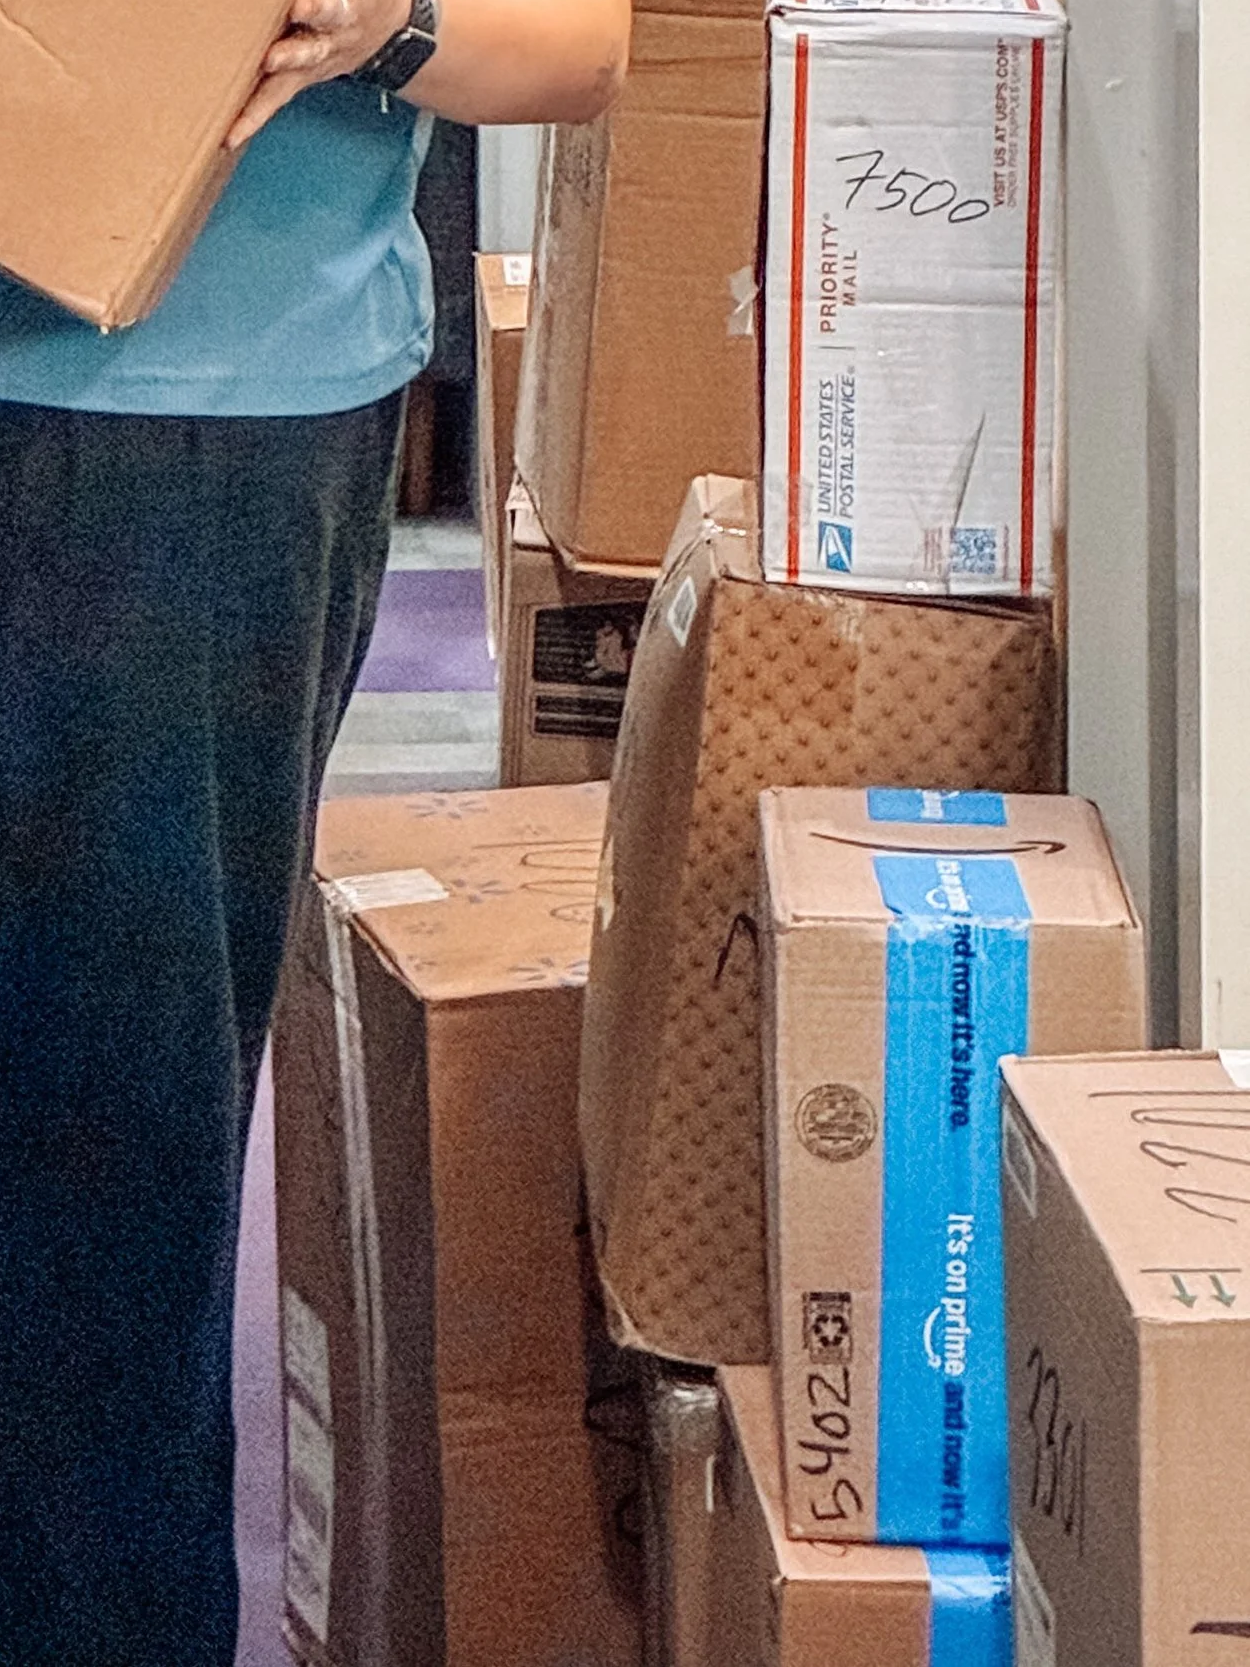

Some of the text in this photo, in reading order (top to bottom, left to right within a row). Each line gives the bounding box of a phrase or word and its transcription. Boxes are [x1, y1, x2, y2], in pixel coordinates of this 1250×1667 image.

[993, 146, 1006, 167] US
[994, 125, 1006, 143] AT
[834, 148, 991, 224] 7500
[992, 172, 1005, 208] VISIT
[842, 249, 858, 307] MAIL
[817, 378, 833, 514] UNITED STATES
[839, 452, 854, 520] POSTAL
[952, 962, 970, 1020] now
[945, 1213, 974, 1255] It's
[946, 1259, 968, 1292] on
[940, 1297, 972, 1377] prime
[942, 1382, 968, 1429] and
[796, 1366, 864, 1522] 5402
[942, 1434, 963, 1488] now
